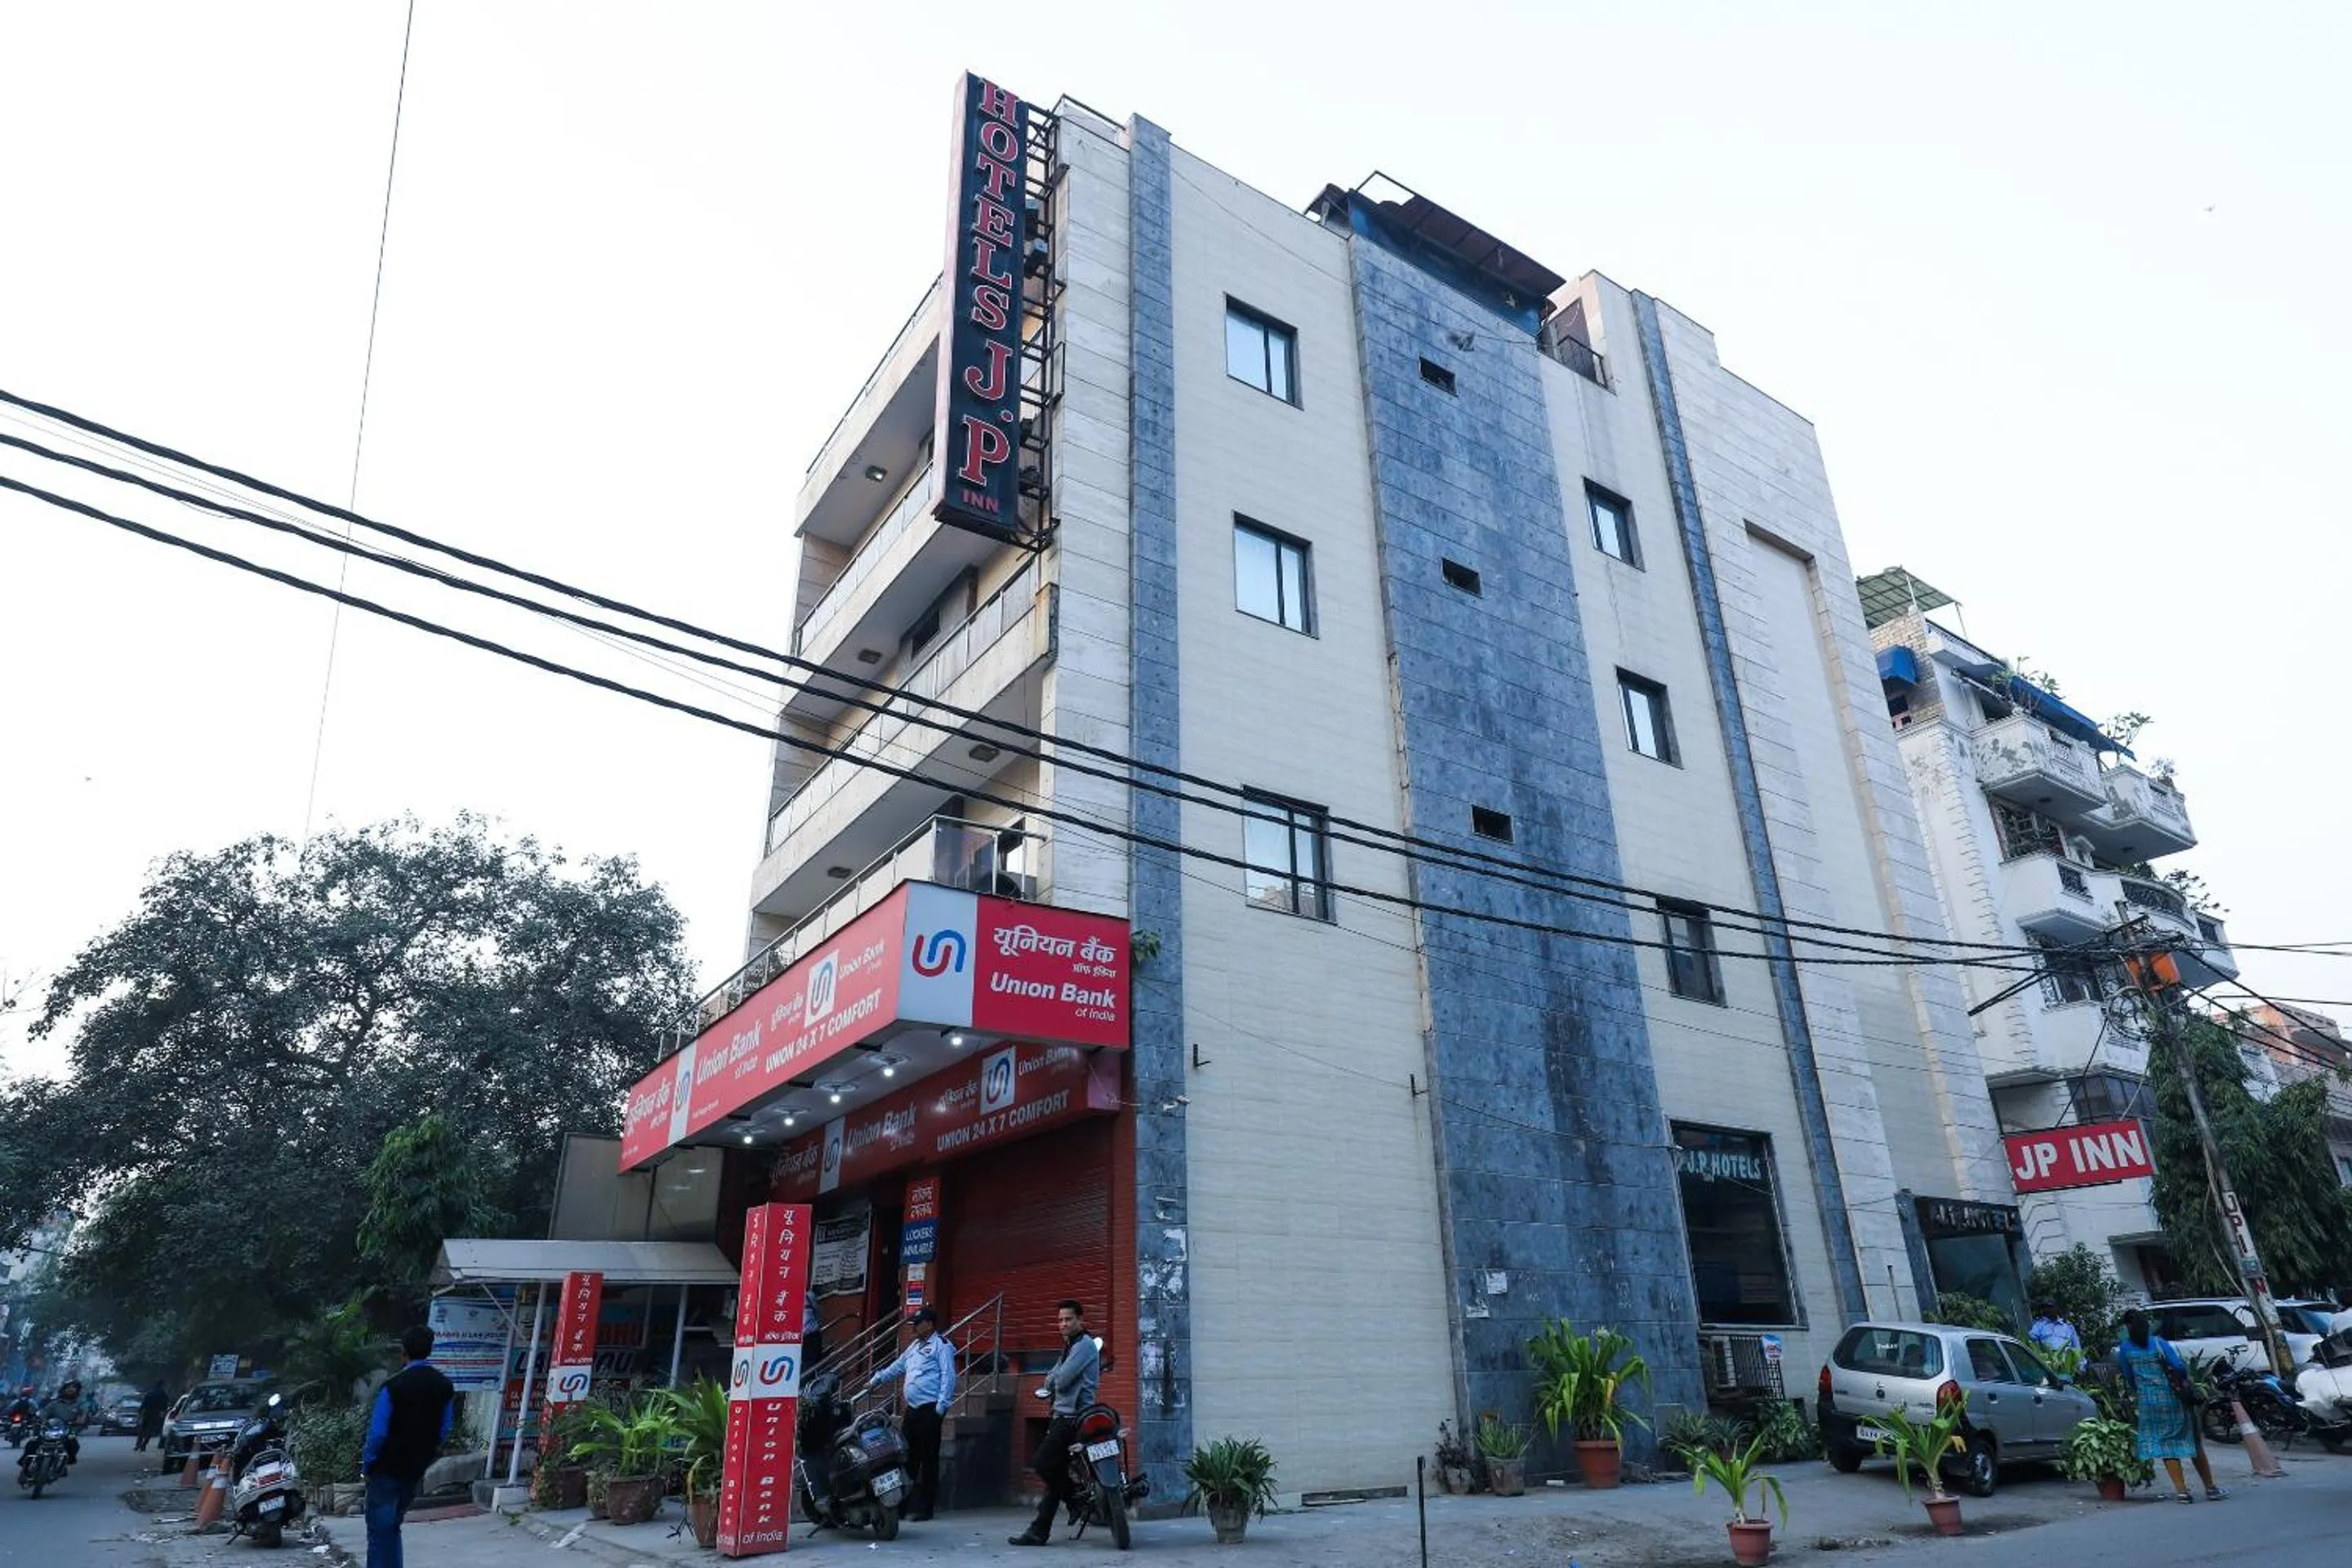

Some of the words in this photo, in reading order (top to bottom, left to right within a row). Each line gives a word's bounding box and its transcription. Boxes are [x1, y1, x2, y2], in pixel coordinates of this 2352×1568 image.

[970, 77, 1020, 332] HOTELS
[962, 488, 1000, 514] INN
[993, 924, 1077, 958] यूनियन
[1080, 934, 1117, 963] बैंक
[990, 971, 1056, 1000] Union
[1060, 982, 1116, 1009] Bank
[764, 1039, 795, 1075] UNION
[808, 1026, 819, 1049] X
[818, 1022, 827, 1043] 7
[827, 987, 882, 1038] COMFORT
[1075, 1007, 1088, 1018] of
[697, 1046, 729, 1086] Union
[728, 1018, 764, 1065] Bank
[987, 1116, 997, 1134] X
[998, 1111, 1007, 1132] 7
[1008, 1088, 1071, 1129] COMFORT
[1711, 1152, 1762, 1180] HOTELS
[2016, 1143, 2057, 1181] JP
[2069, 1129, 2146, 1174] INN
